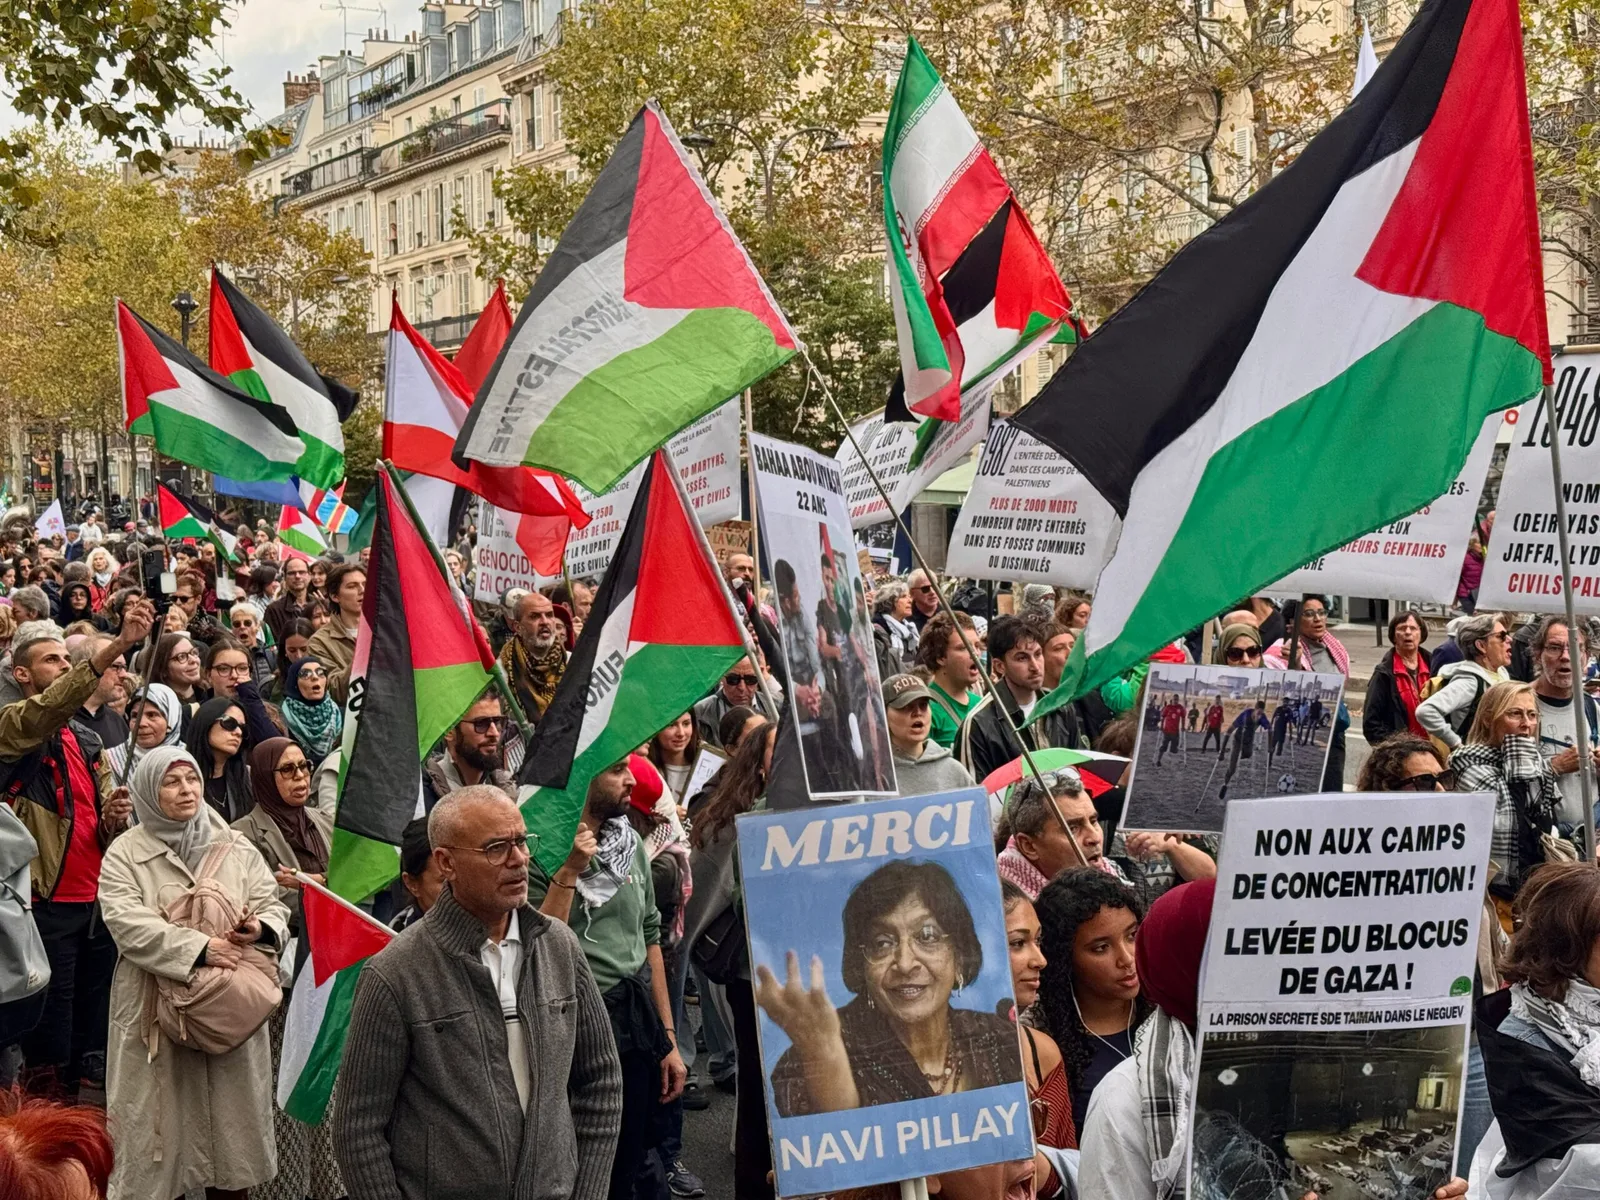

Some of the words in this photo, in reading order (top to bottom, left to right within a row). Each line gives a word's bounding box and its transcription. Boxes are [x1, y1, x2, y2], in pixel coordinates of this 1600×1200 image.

[1029, 438, 1045, 447] LIBA
[897, 447, 907, 459] SE
[1014, 450, 1043, 460] L'ENTRÉE
[1044, 451, 1057, 460] DES
[691, 453, 727, 475] MARTYRS,
[754, 444, 792, 478] BAHAA
[790, 454, 817, 485] ABOU
[1009, 465, 1028, 474] DANS
[1028, 465, 1043, 474] CES
[1044, 466, 1066, 475] CAMPS
[1005, 478, 1051, 488] PALESTINIENS
[707, 487, 731, 504] CIVILS
[797, 490, 810, 511] 22
[812, 494, 827, 517] ANS
[989, 497, 1009, 511] PLUS
[1011, 498, 1022, 511] DE
[1024, 499, 1046, 512] 2000
[1048, 500, 1078, 514] MORTS
[595, 504, 613, 520] 2500
[867, 499, 889, 514] MORT
[971, 515, 1014, 530] NOMBREUX
[1016, 518, 1043, 532] CORPS
[1044, 519, 1086, 535] ENTERRÉS
[1388, 522, 1411, 535] EUX
[1513, 513, 1558, 533] (DEIR
[571, 547, 578, 558] LA
[581, 539, 611, 556] PLUPART
[964, 534, 985, 547] DANS
[986, 535, 1002, 548] DES
[1003, 537, 1034, 551] FOSSES
[1036, 539, 1086, 556] COMMUNES
[1340, 540, 1380, 553] SIEURS
[1383, 541, 1447, 558] CENTAINES
[1503, 543, 1559, 566] JAFFA,
[573, 562, 585, 574] DES
[588, 556, 610, 571] CIVILS
[988, 555, 999, 568] OU
[1001, 556, 1051, 573] DISSIMULÉS
[480, 572, 492, 593] EN
[1508, 573, 1562, 595] CIVILS
[760, 801, 975, 871] MERCI
[1254, 829, 1312, 856] NON
[1319, 827, 1373, 854] AUX
[1381, 823, 1466, 854] CAMPS
[1232, 873, 1267, 900] DE
[1224, 920, 1316, 955] LEVÉE
[1321, 925, 1361, 954] DU
[1365, 918, 1469, 952] BLOCUS
[1279, 967, 1319, 995] DE
[1324, 963, 1399, 994] GAZA
[1209, 1013, 1224, 1026] LA
[1226, 1012, 1268, 1025] PRISON
[1269, 1012, 1318, 1025] SECRETE
[1320, 1012, 1341, 1025] SDE
[1343, 1010, 1383, 1024] TAIMAN
[1384, 1009, 1412, 1023] DANS
[1413, 1009, 1426, 1022] LE
[1426, 1005, 1464, 1021] NEGUEV
[780, 1124, 884, 1171] NAVI
[897, 1102, 1020, 1154] PILLAY
